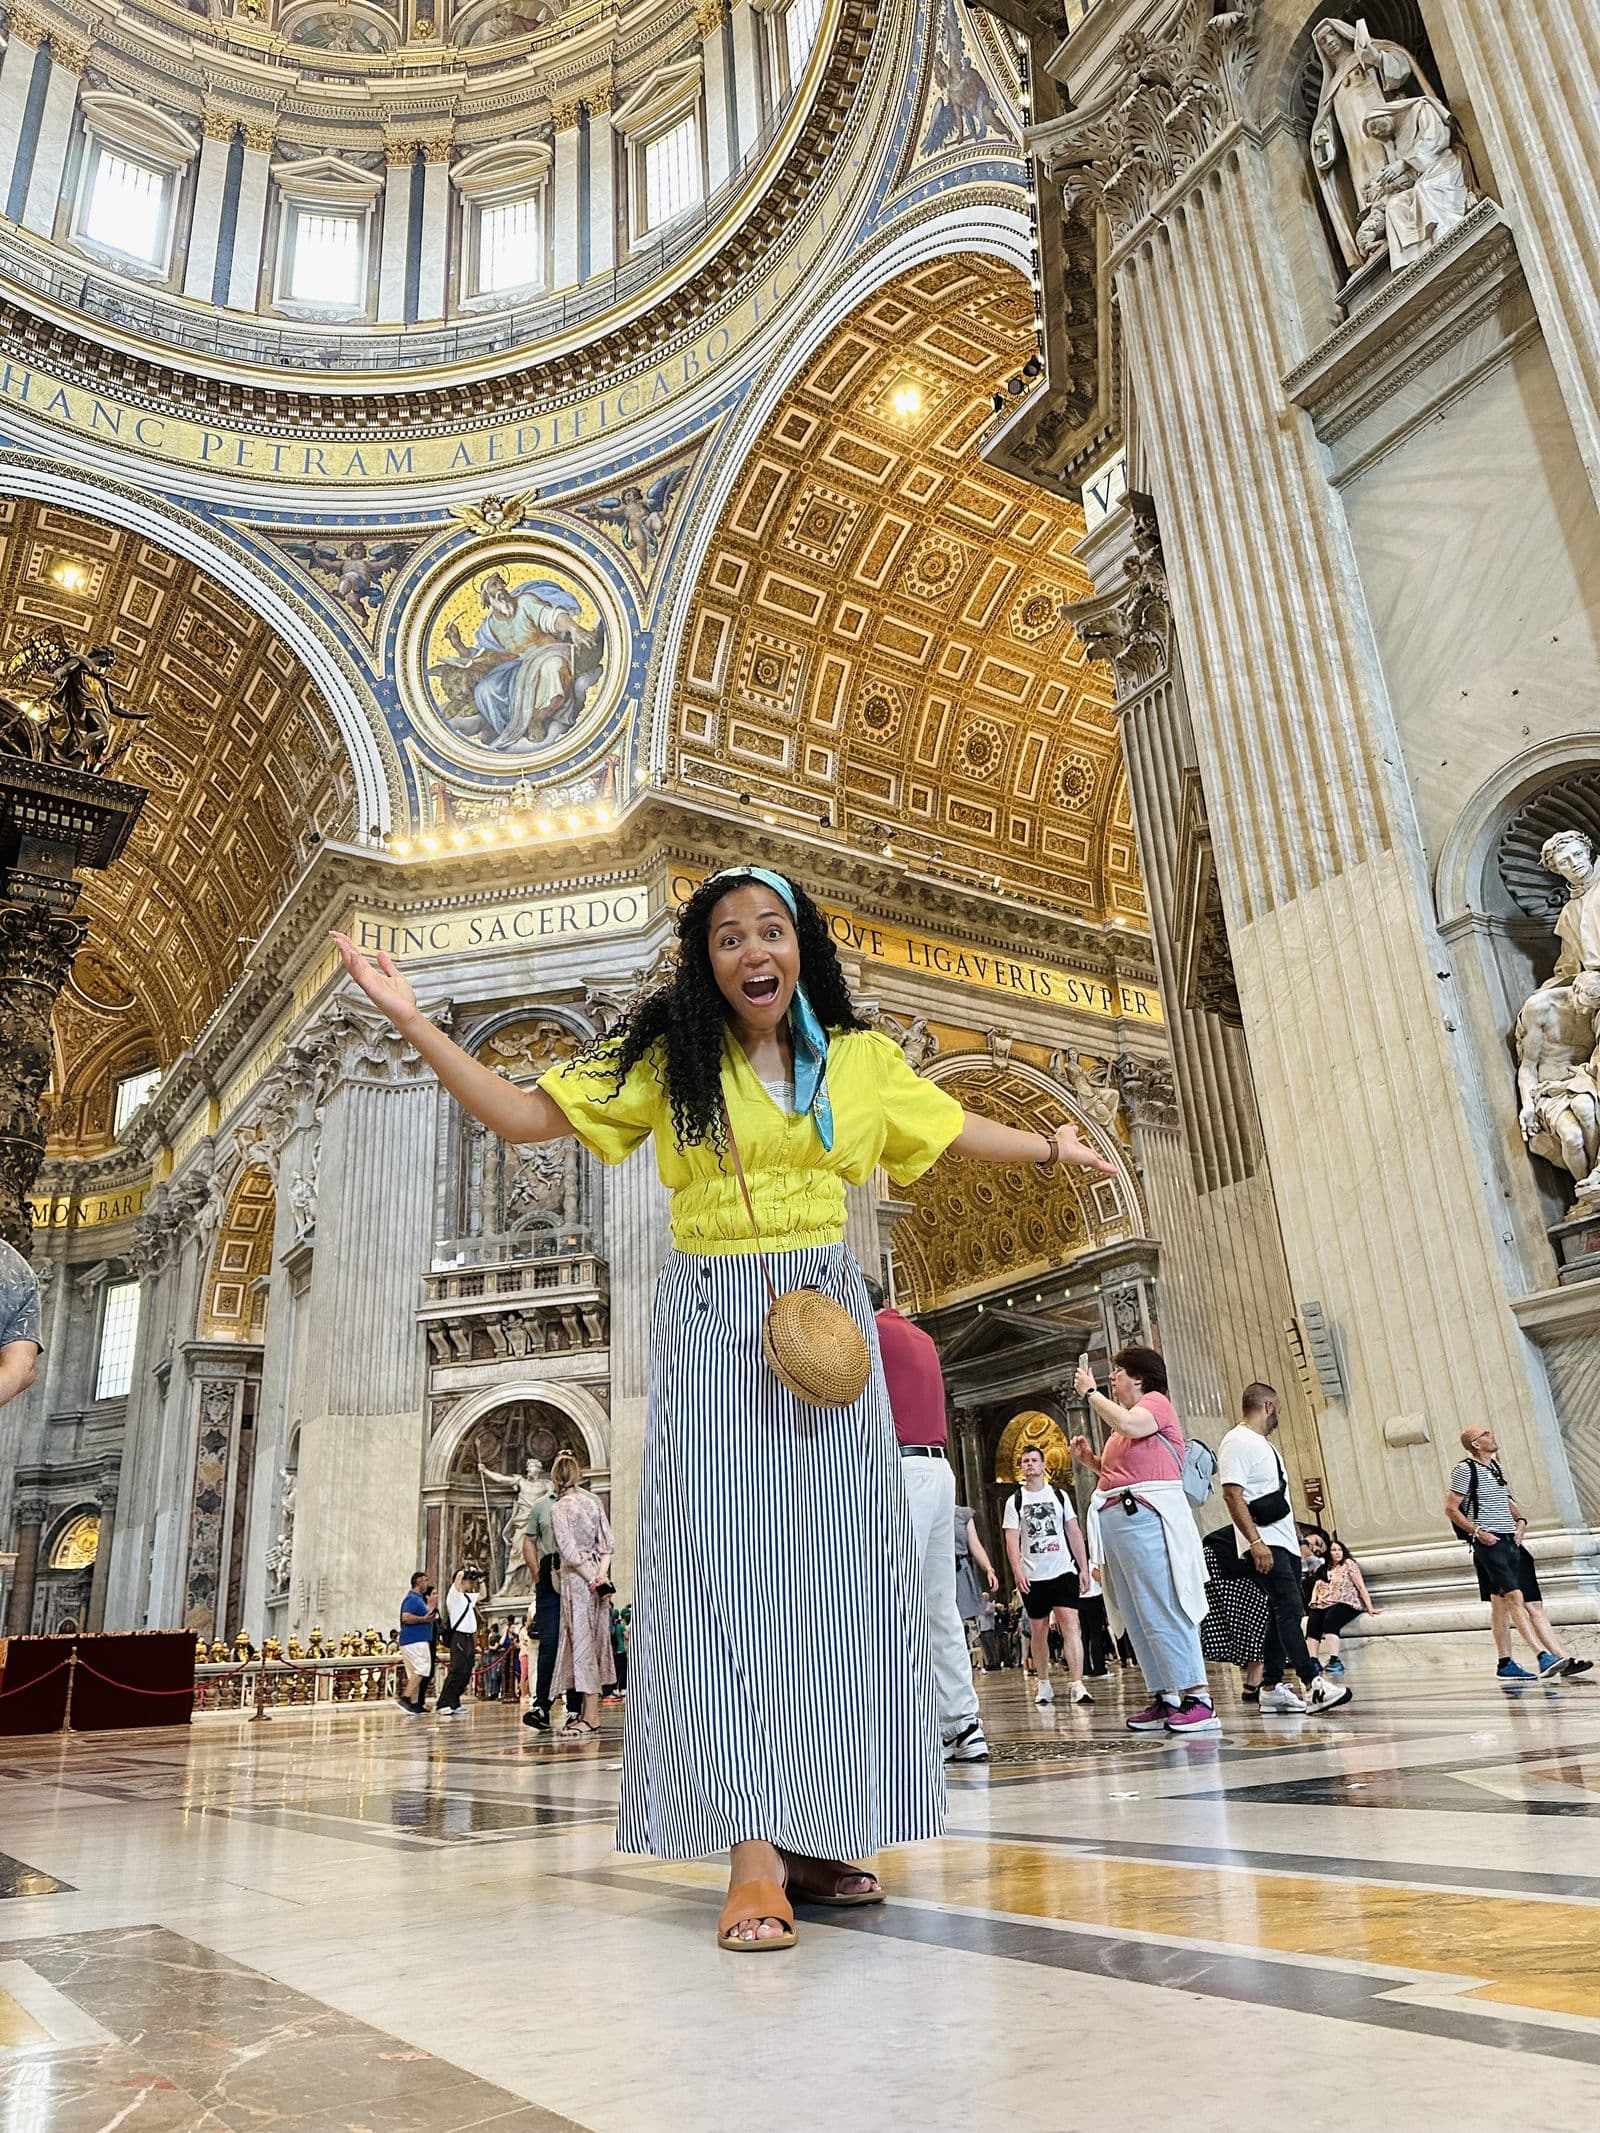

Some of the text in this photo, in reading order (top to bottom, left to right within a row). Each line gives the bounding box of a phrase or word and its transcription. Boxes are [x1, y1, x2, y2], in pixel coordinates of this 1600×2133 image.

[1, 327, 730, 476] HANC PETRAM AEDIFICABO
[358, 896, 637, 955] HINC SACERDO
[905, 938, 1052, 996] LIGAVERIS
[1067, 979, 1152, 1017] SVPER
